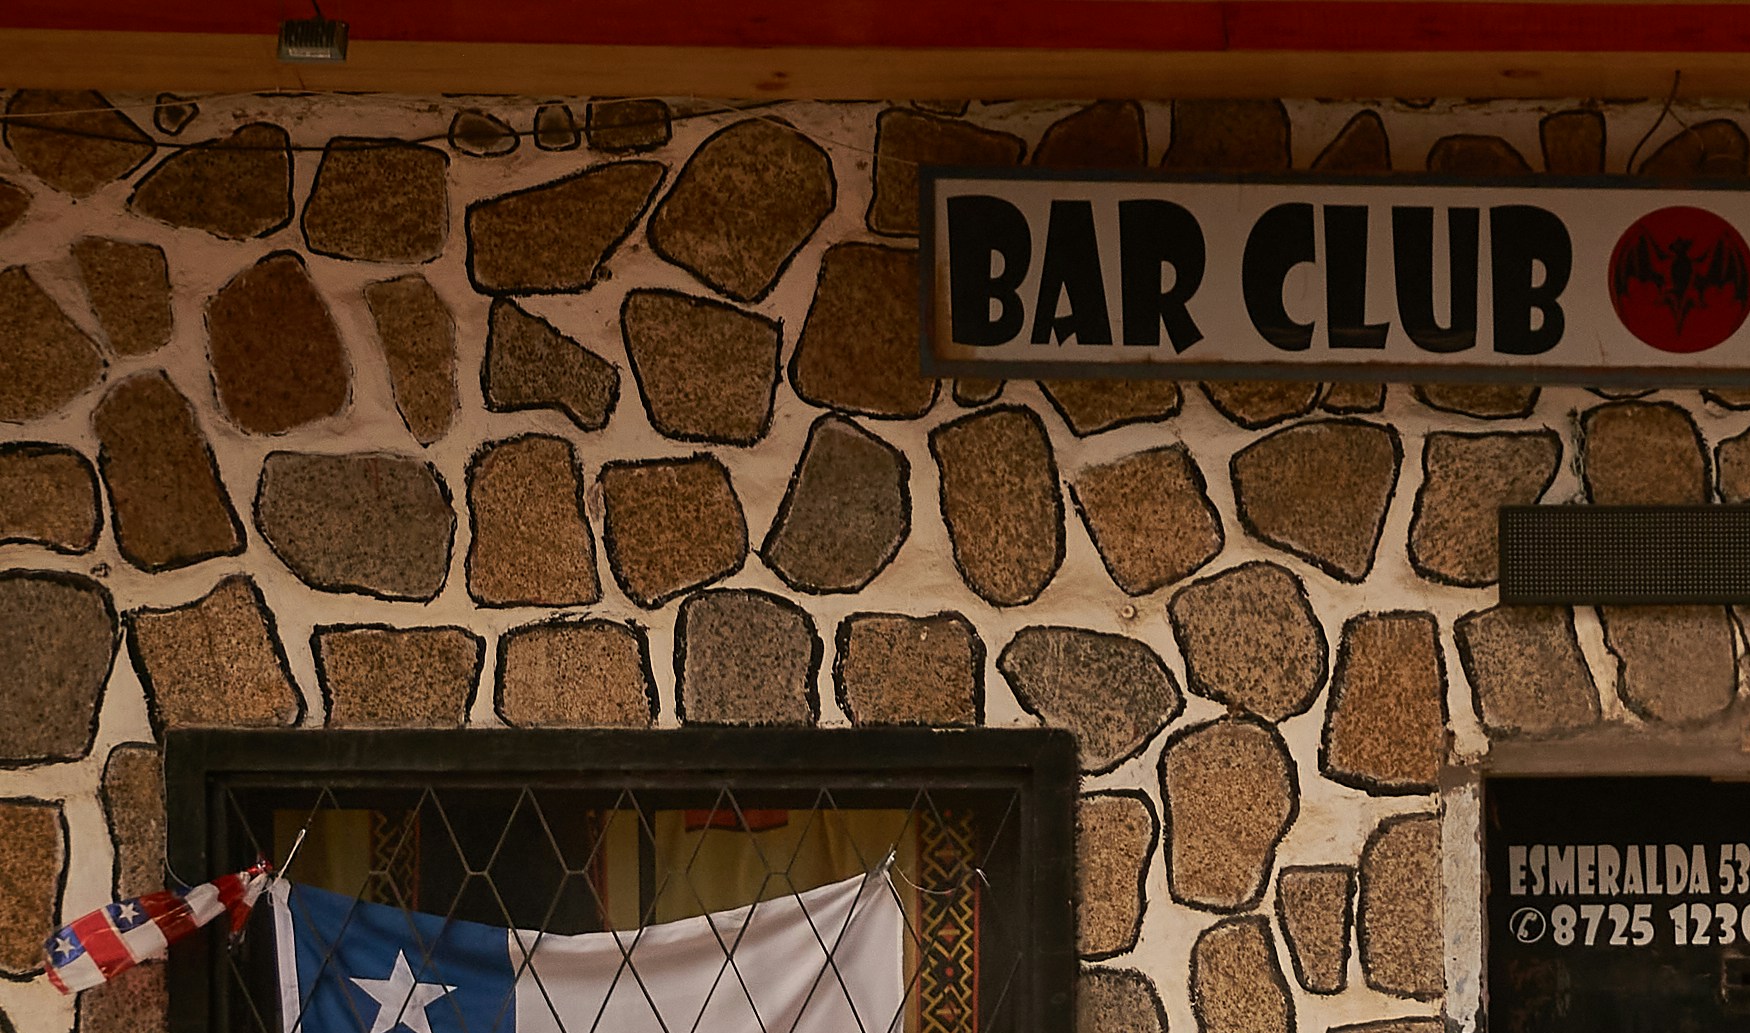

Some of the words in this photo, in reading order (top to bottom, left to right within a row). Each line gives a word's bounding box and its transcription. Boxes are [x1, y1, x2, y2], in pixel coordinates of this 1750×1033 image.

[947, 195, 1206, 354] BAR
[1241, 202, 1573, 355] CLUB
[1508, 844, 1711, 898] ESMERALDA
[1550, 904, 1655, 946] 8725
